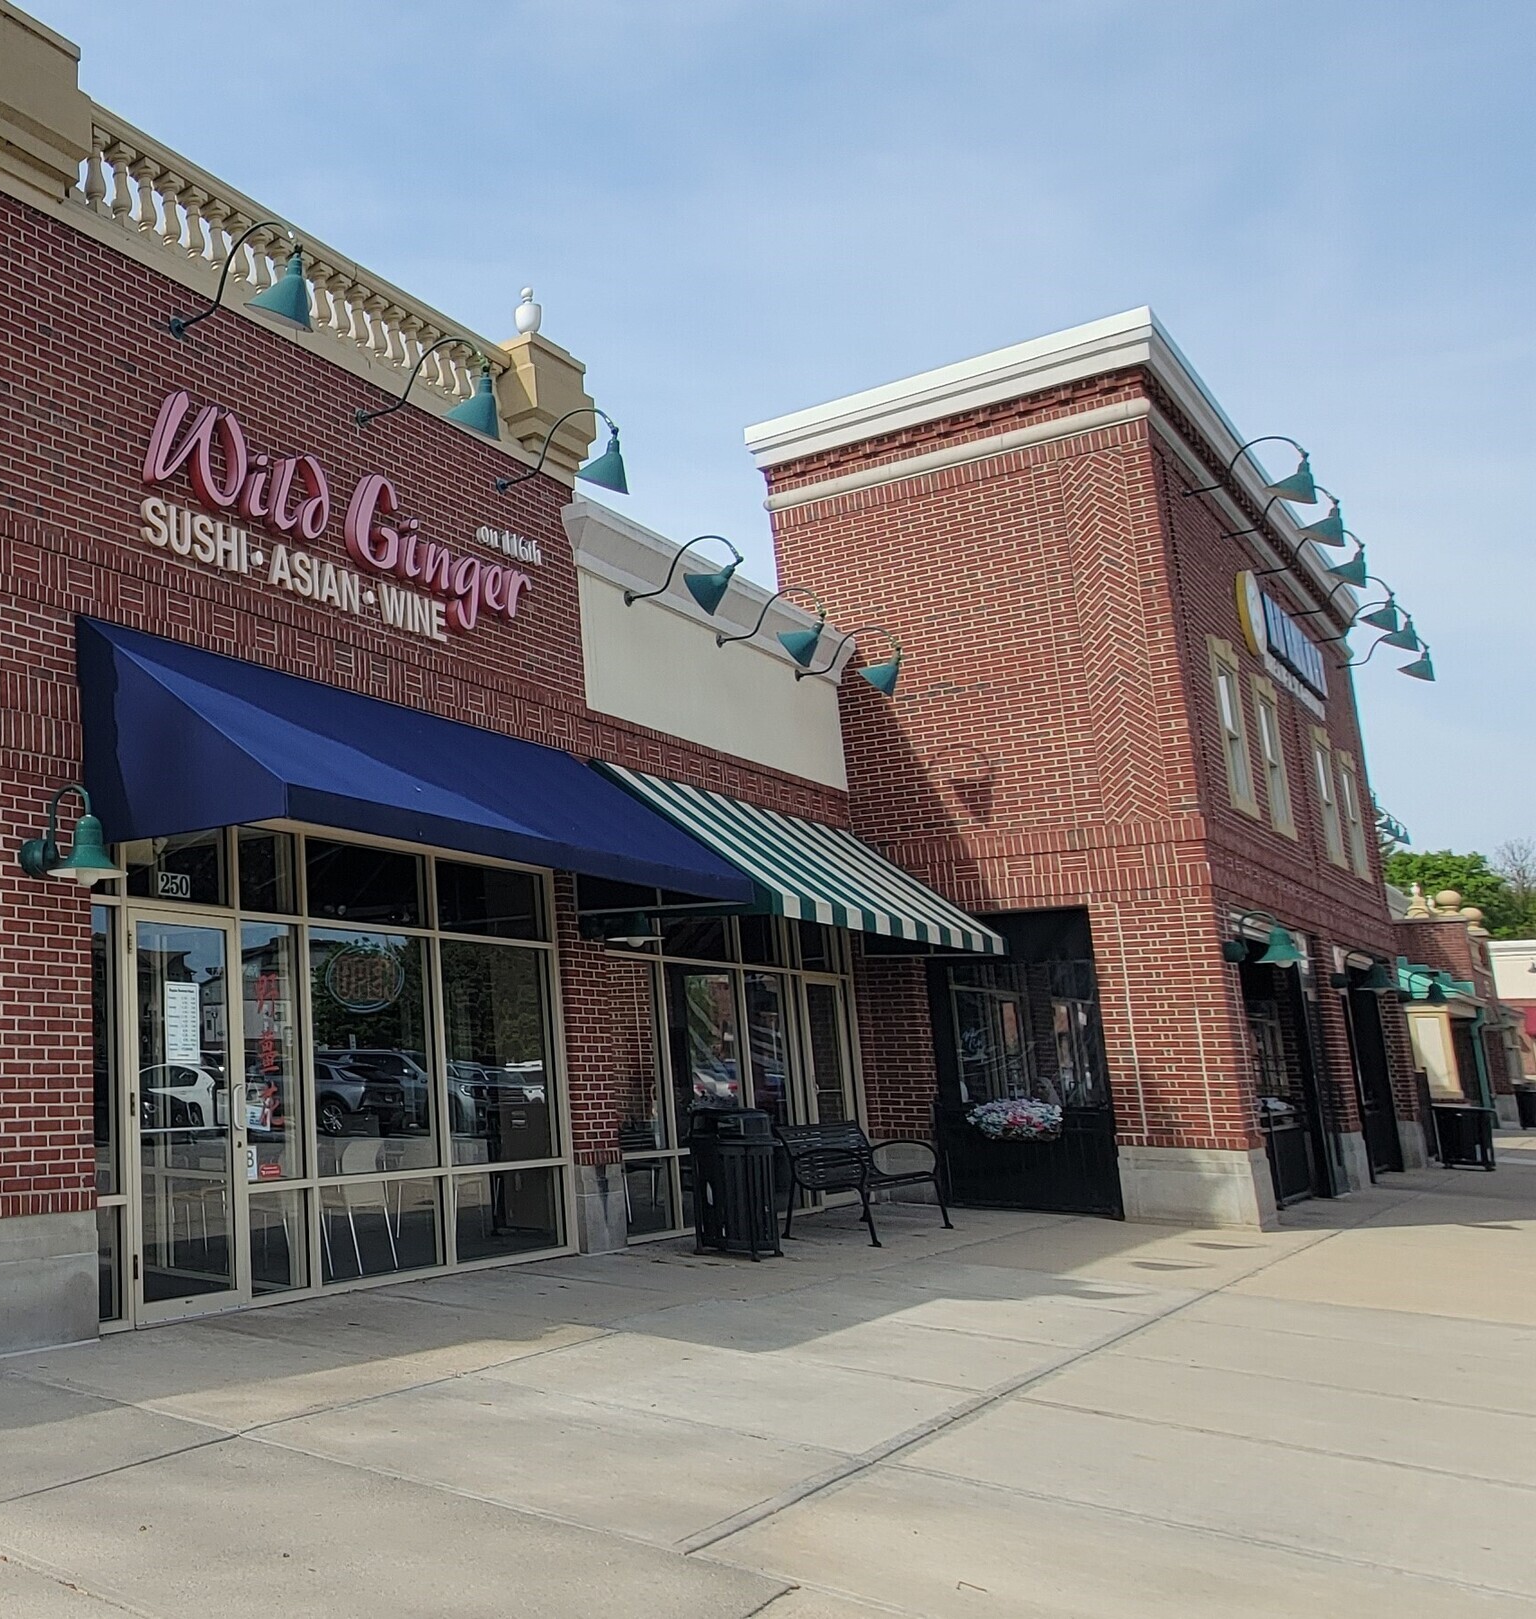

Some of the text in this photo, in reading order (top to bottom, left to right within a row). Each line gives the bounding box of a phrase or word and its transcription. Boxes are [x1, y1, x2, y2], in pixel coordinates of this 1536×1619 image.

[143, 389, 532, 631] Wild Ginger
[476, 525, 542, 566] on 116th
[140, 497, 448, 642] SUSHI ASIAN WINE
[160, 873, 189, 896] 250
